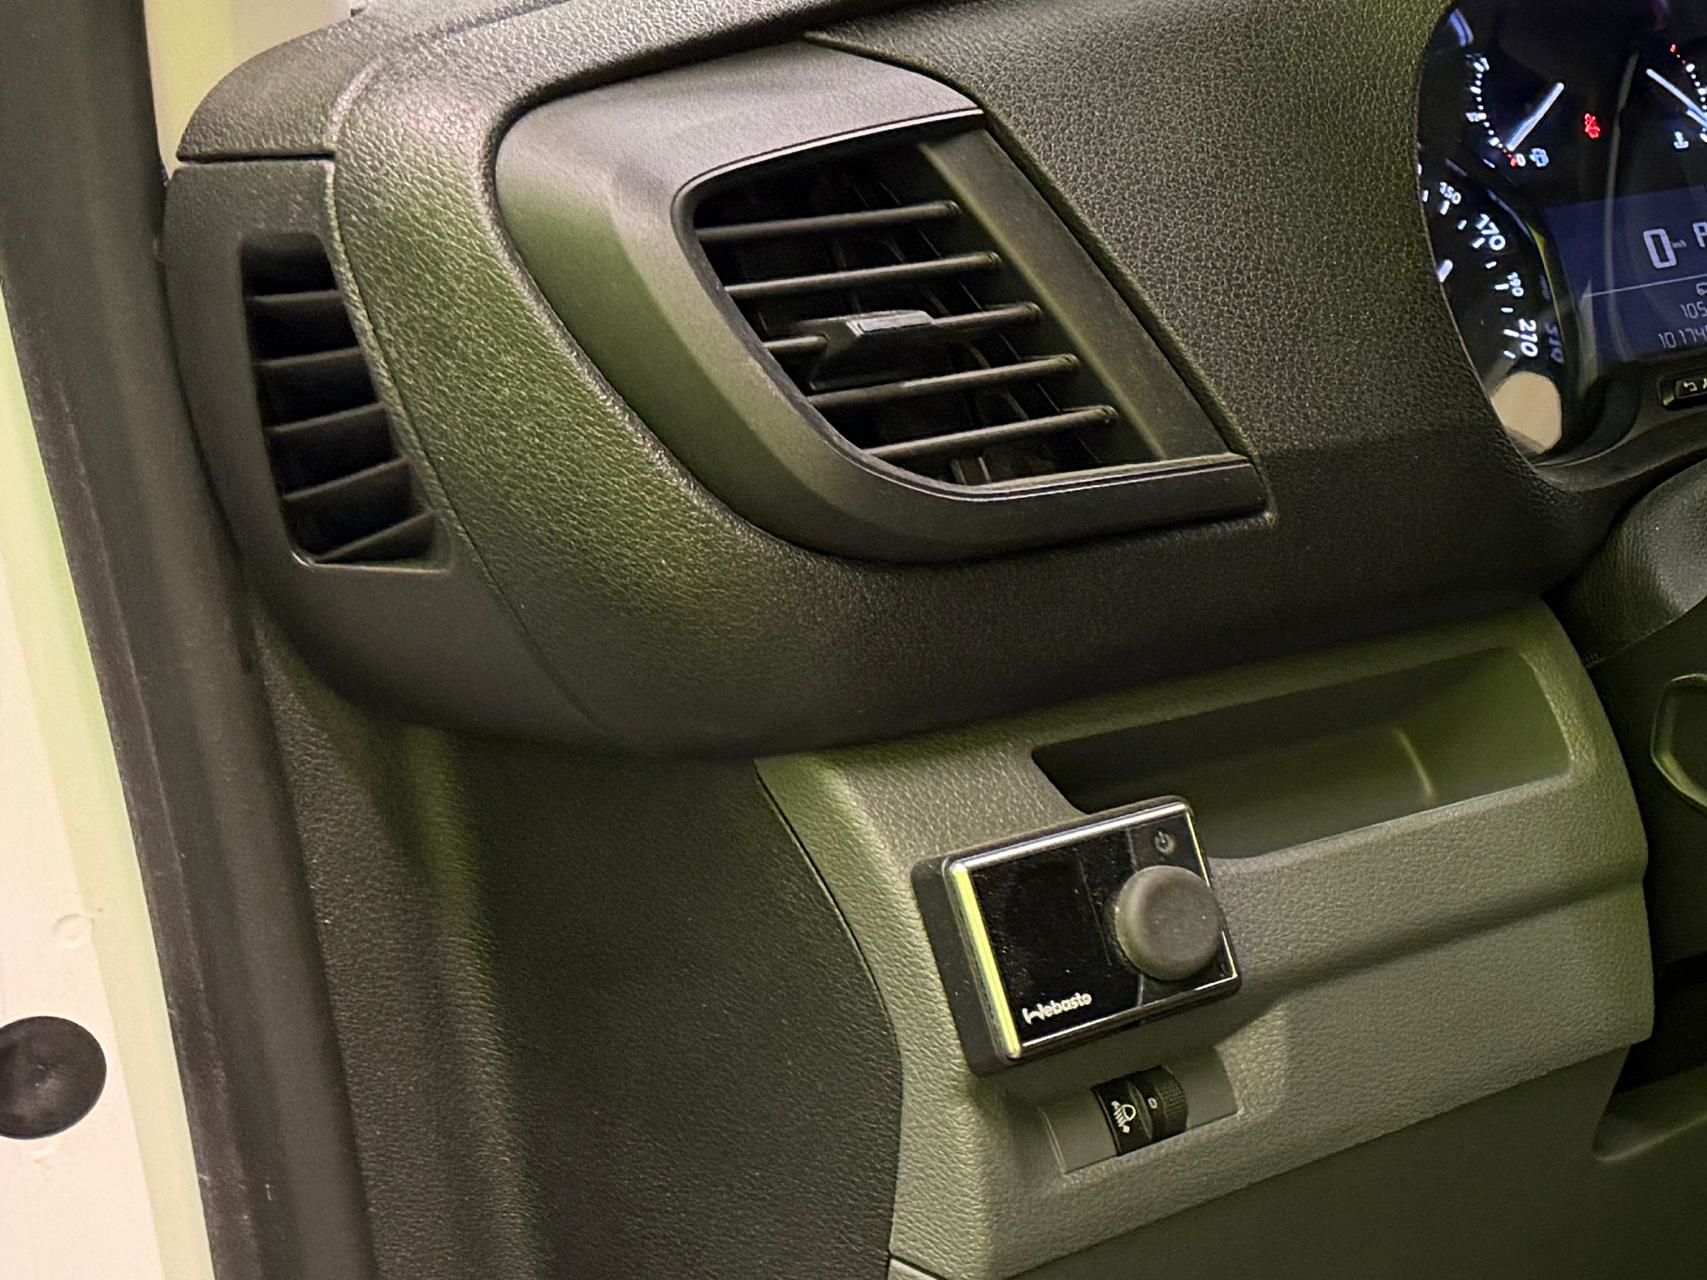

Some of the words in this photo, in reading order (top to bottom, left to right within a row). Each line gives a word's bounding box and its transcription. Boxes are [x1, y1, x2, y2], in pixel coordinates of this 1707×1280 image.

[1475, 213, 1506, 251] 170
[1643, 228, 1677, 269] 0
[1506, 271, 1525, 297] 190
[1518, 317, 1539, 357] 210
[1021, 992, 1093, 1025] Webasto
